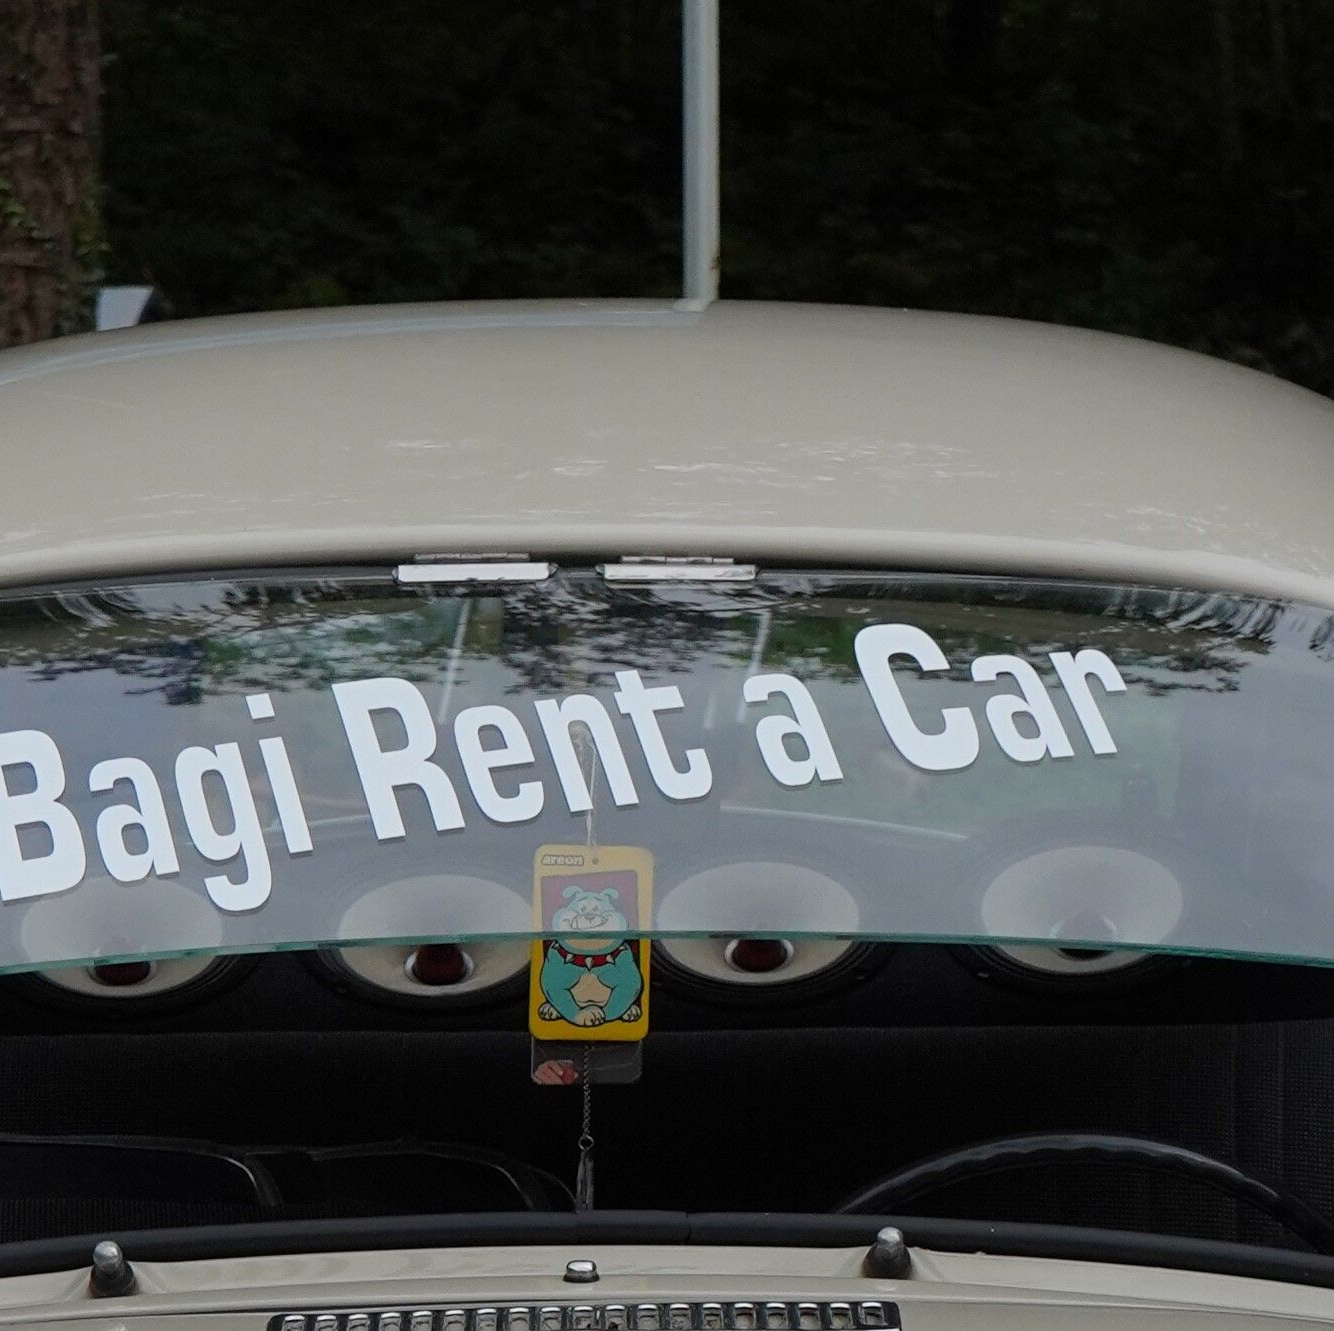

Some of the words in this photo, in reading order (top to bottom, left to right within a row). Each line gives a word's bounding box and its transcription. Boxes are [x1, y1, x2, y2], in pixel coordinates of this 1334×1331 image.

[332, 669, 712, 840] Rent
[743, 673, 843, 786] a
[854, 624, 1127, 770] Car
[541, 854, 585, 867] areon
